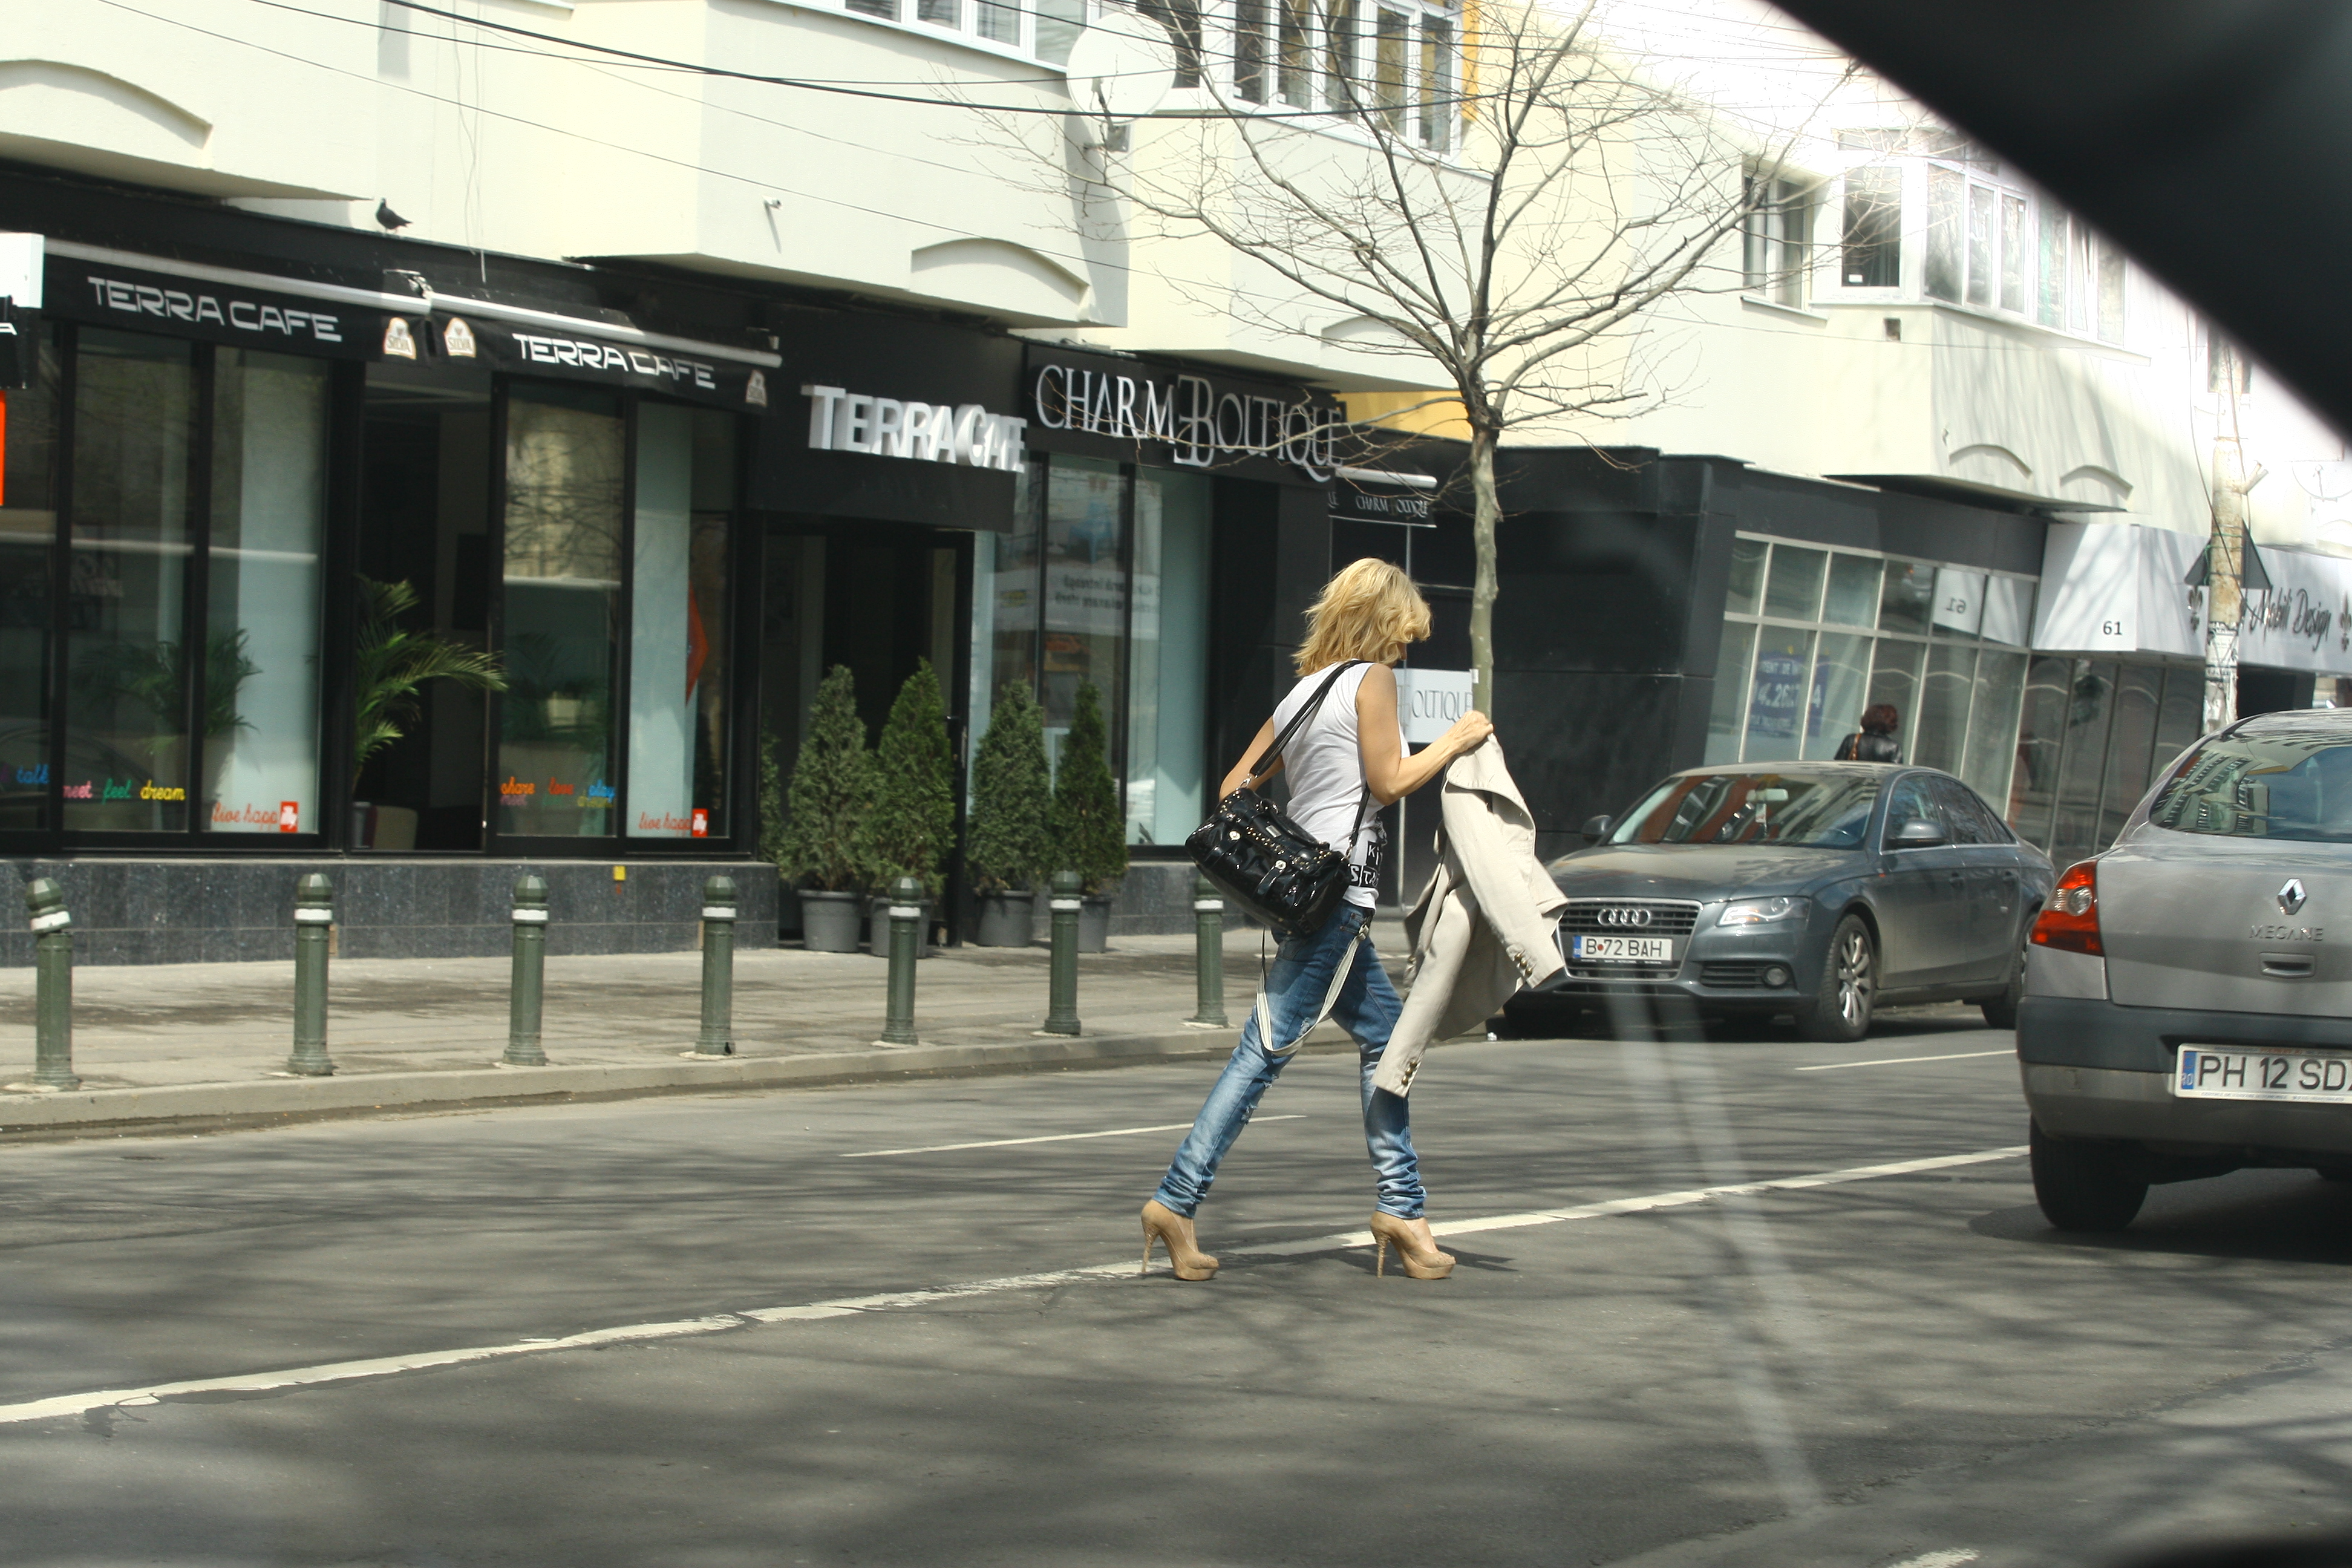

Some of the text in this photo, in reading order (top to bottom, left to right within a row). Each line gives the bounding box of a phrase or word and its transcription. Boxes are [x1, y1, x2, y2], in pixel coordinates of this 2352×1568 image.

[87, 276, 342, 342] TERRA CAFE
[512, 333, 716, 390] TERRA CAFE
[1036, 364, 1175, 444] CHARM
[800, 384, 958, 464] TERRA
[1355, 495, 1389, 512] CHARM
[2103, 621, 2123, 636] 61
[2293, 589, 2331, 652] Design
[16, 763, 50, 784] talk
[140, 779, 186, 801] dream
[2249, 925, 2323, 941] MEGANE
[1604, 939, 1623, 956] 72
[1628, 940, 1662, 958] BAH
[2198, 1055, 2352, 1091] PH 12 SD
